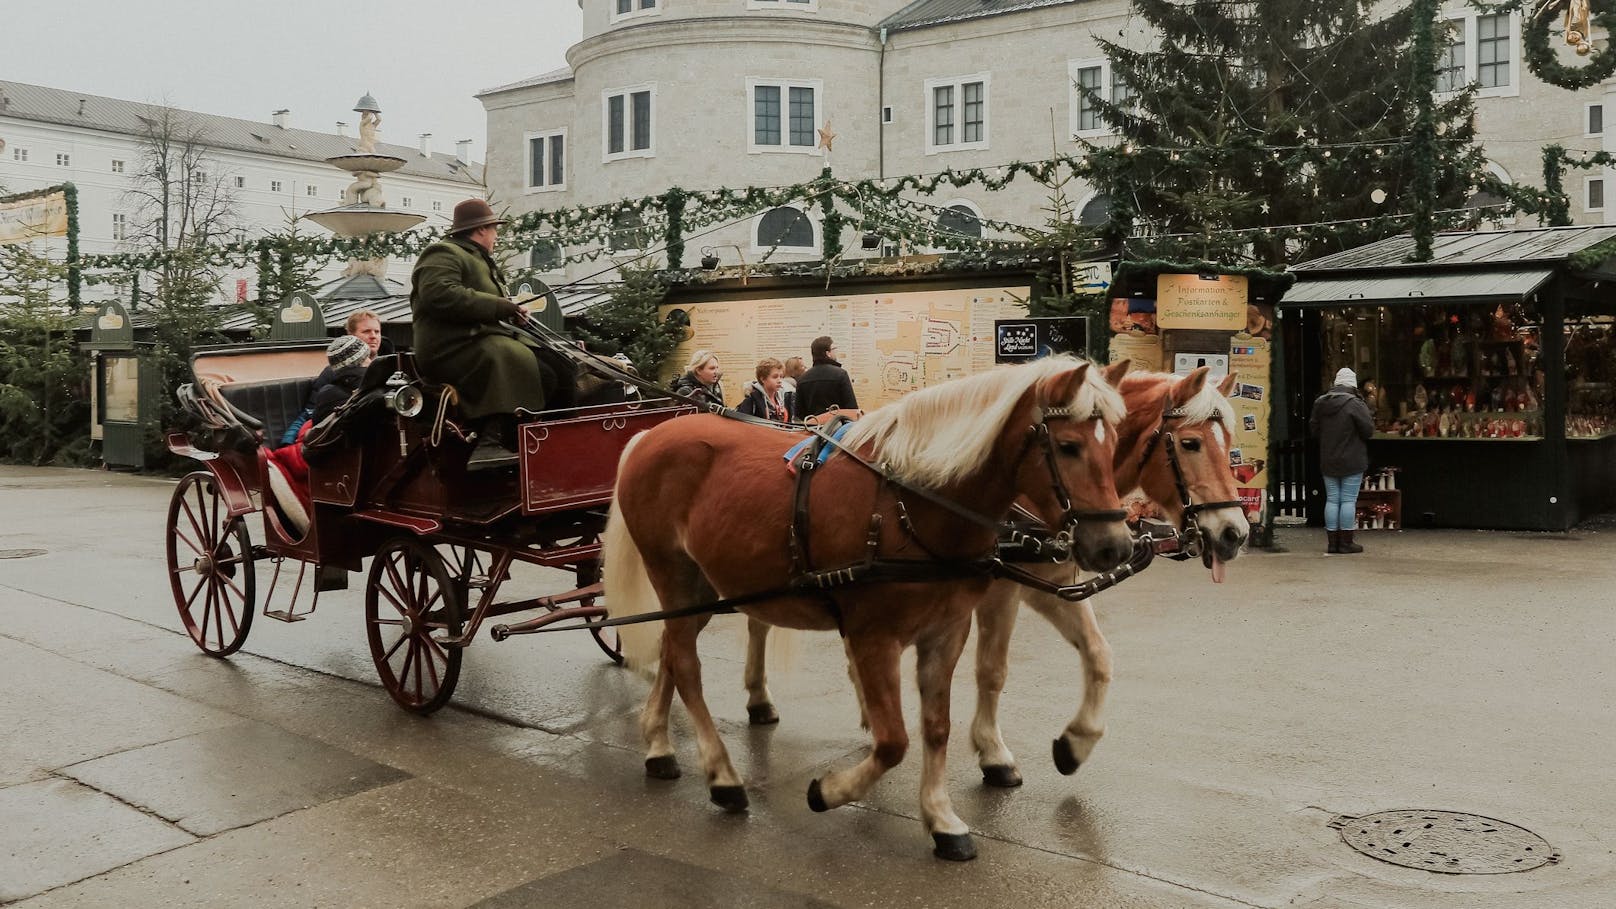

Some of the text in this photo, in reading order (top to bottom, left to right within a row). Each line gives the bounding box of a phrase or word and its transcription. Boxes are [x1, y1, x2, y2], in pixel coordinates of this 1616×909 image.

[1084, 266, 1100, 280] WC
[1178, 285, 1226, 295] Information
[1177, 297, 1221, 306] Postkarten
